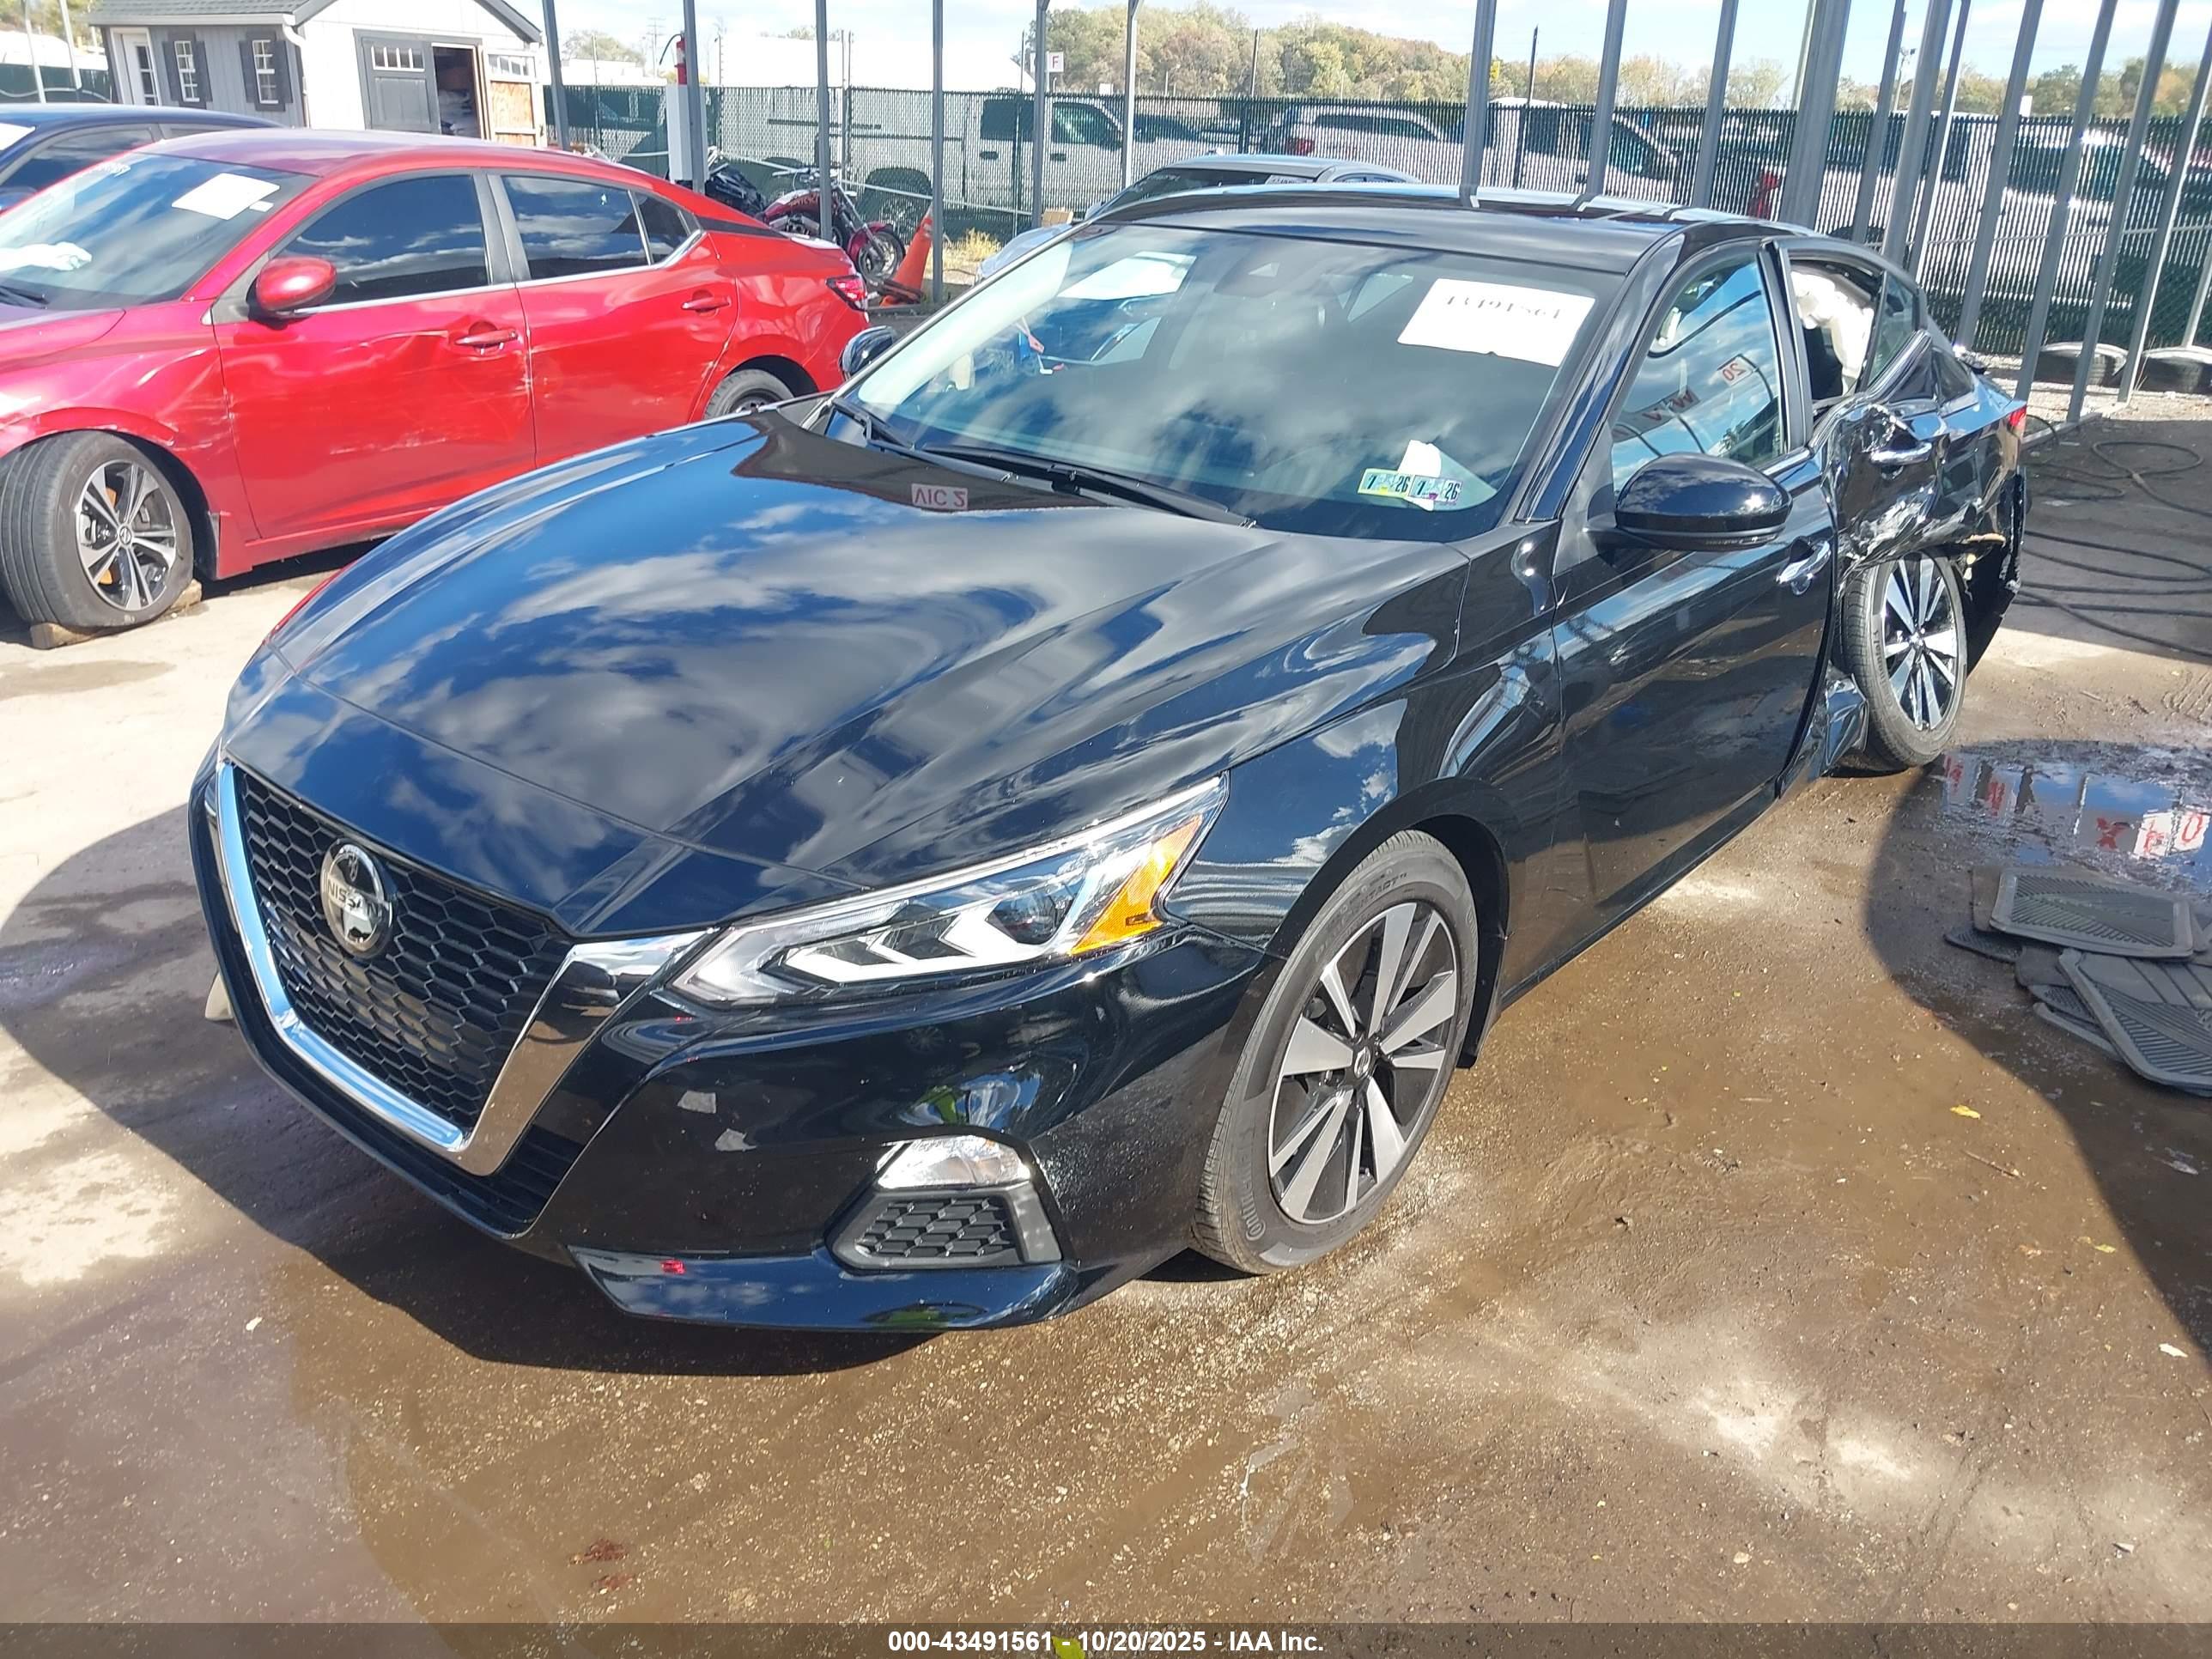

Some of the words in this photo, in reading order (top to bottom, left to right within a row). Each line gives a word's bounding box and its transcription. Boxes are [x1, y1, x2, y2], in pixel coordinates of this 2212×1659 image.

[1052, 55, 1059, 69] F
[1395, 475, 1411, 492] 26
[1445, 482, 1461, 500] 26
